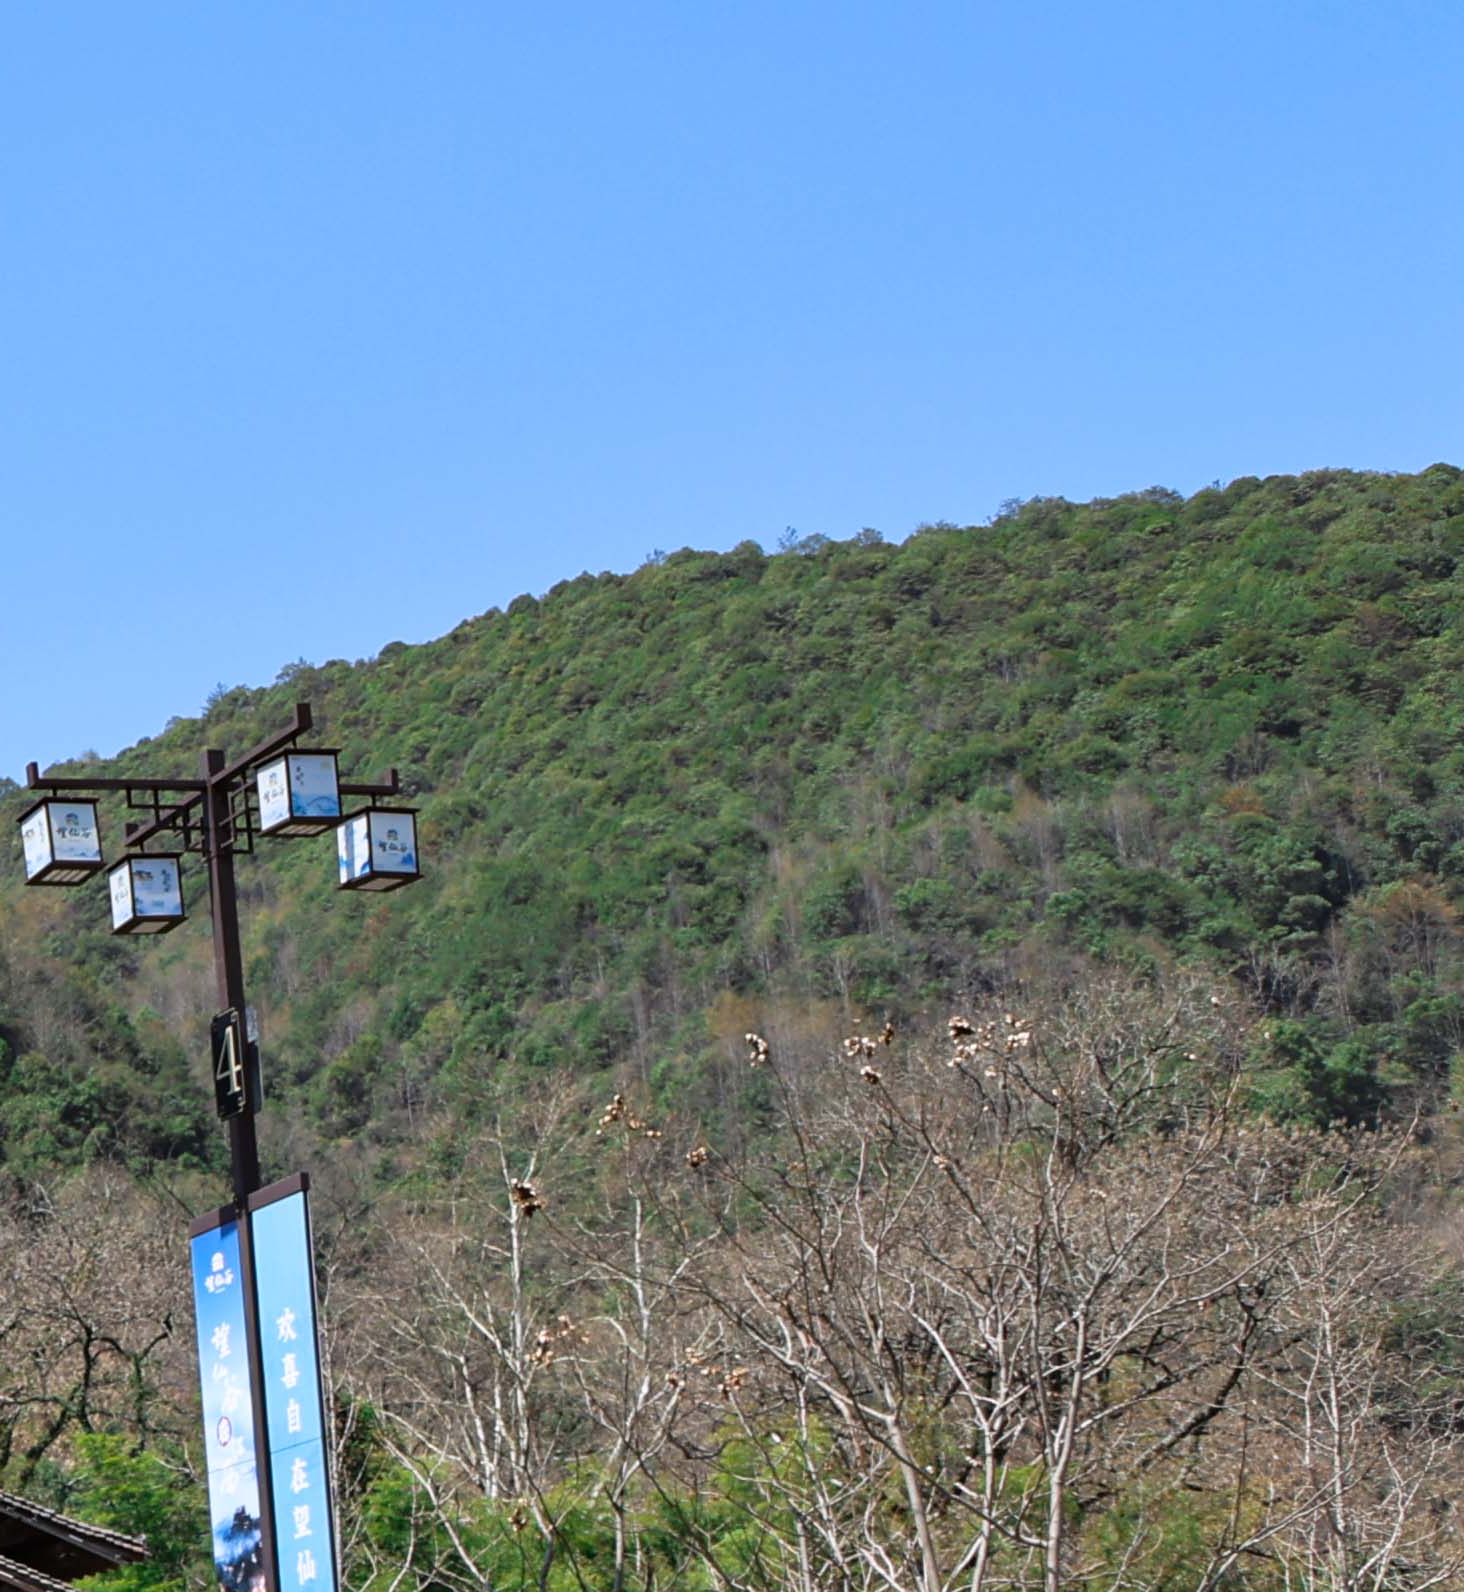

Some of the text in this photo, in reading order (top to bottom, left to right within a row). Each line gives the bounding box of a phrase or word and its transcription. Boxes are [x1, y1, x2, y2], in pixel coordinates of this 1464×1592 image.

[216, 1024, 243, 1096] 4
[275, 1306, 317, 1585] 欢喜自在望仙
